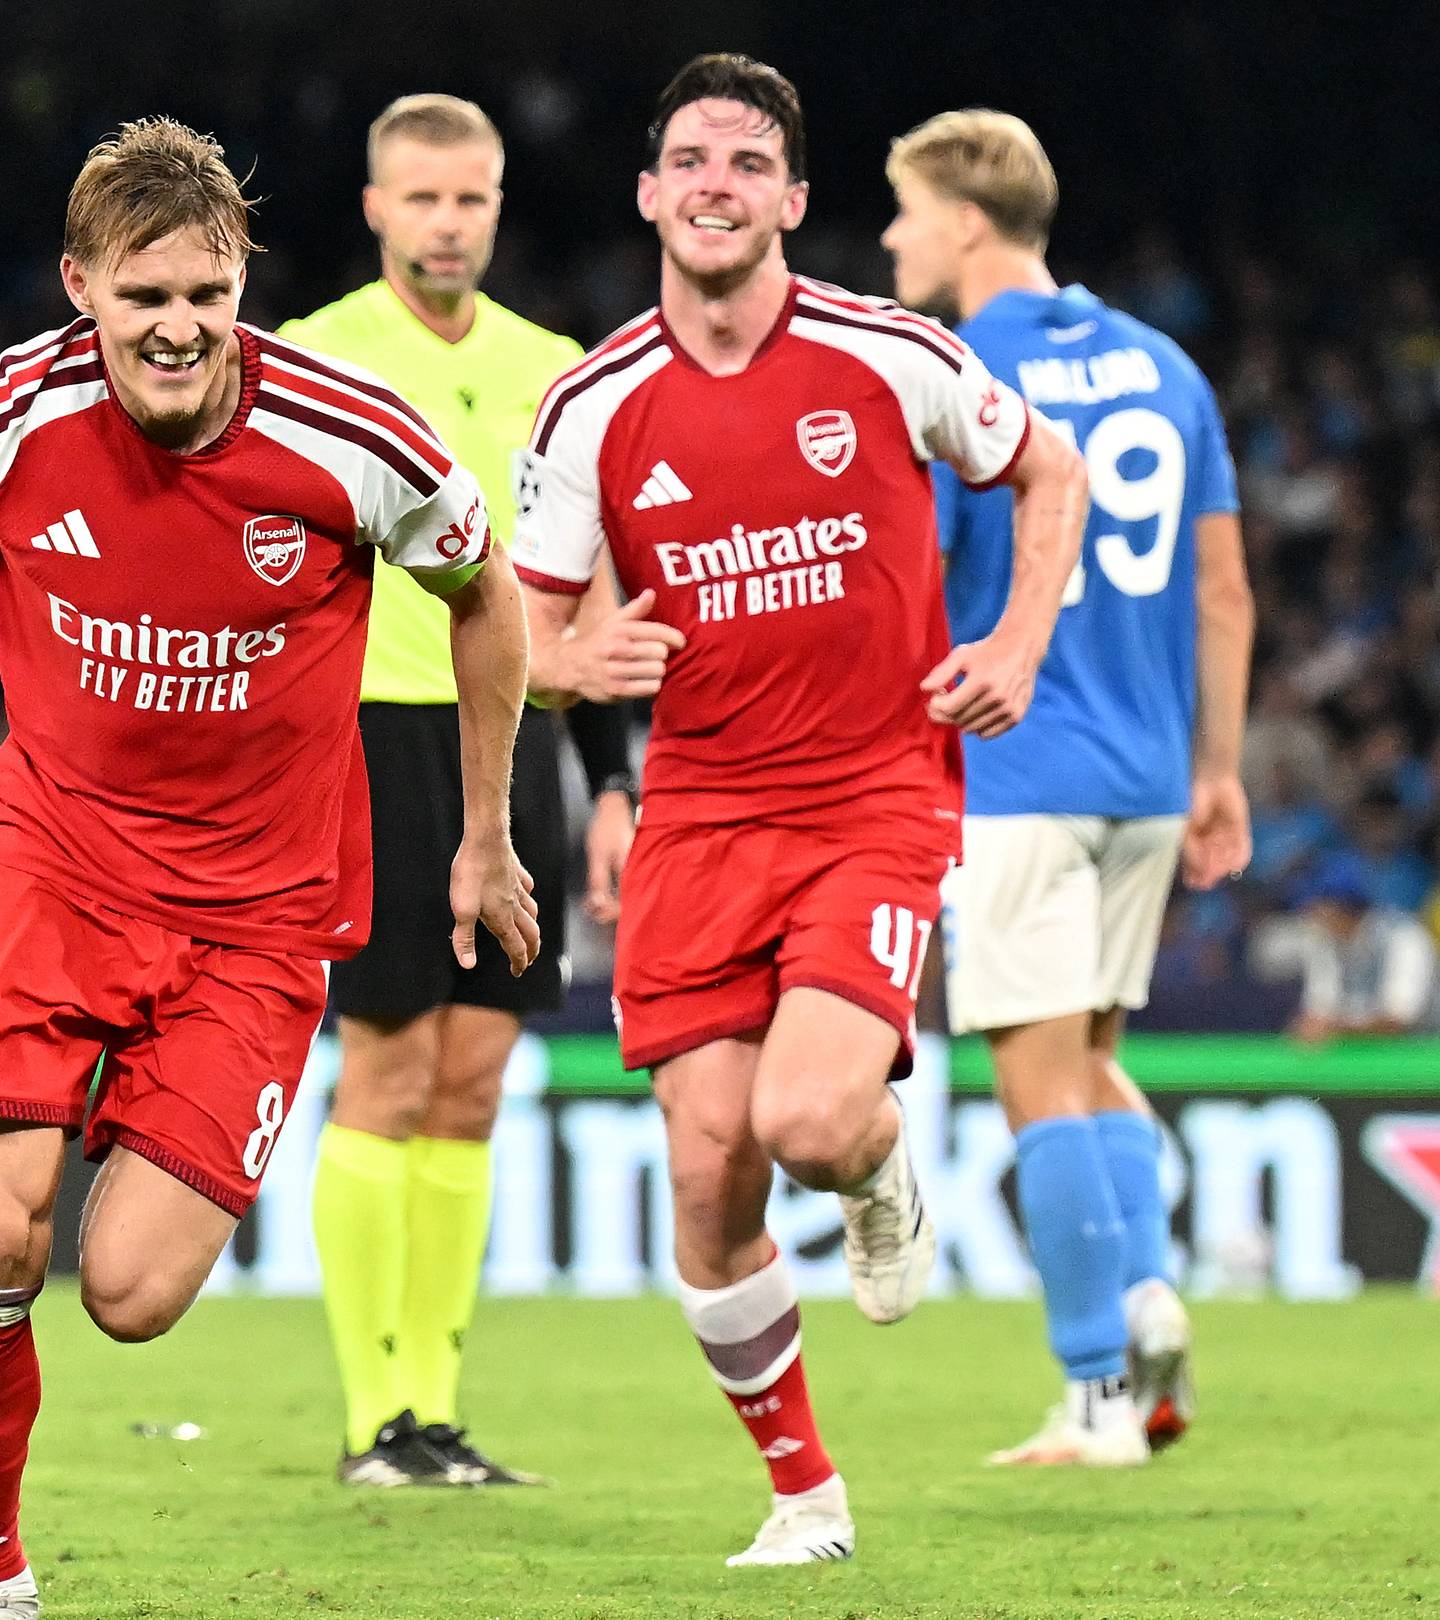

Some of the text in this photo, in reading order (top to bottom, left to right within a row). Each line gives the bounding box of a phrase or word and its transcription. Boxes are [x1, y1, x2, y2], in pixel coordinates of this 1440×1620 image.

[253, 525, 297, 540] Arsenal
[653, 512, 868, 586] Emirates
[697, 560, 846, 623] FLY BETTER
[47, 591, 287, 668] Emirates
[79, 657, 250, 712] FLY BETTER
[242, 1080, 284, 1180] 8
